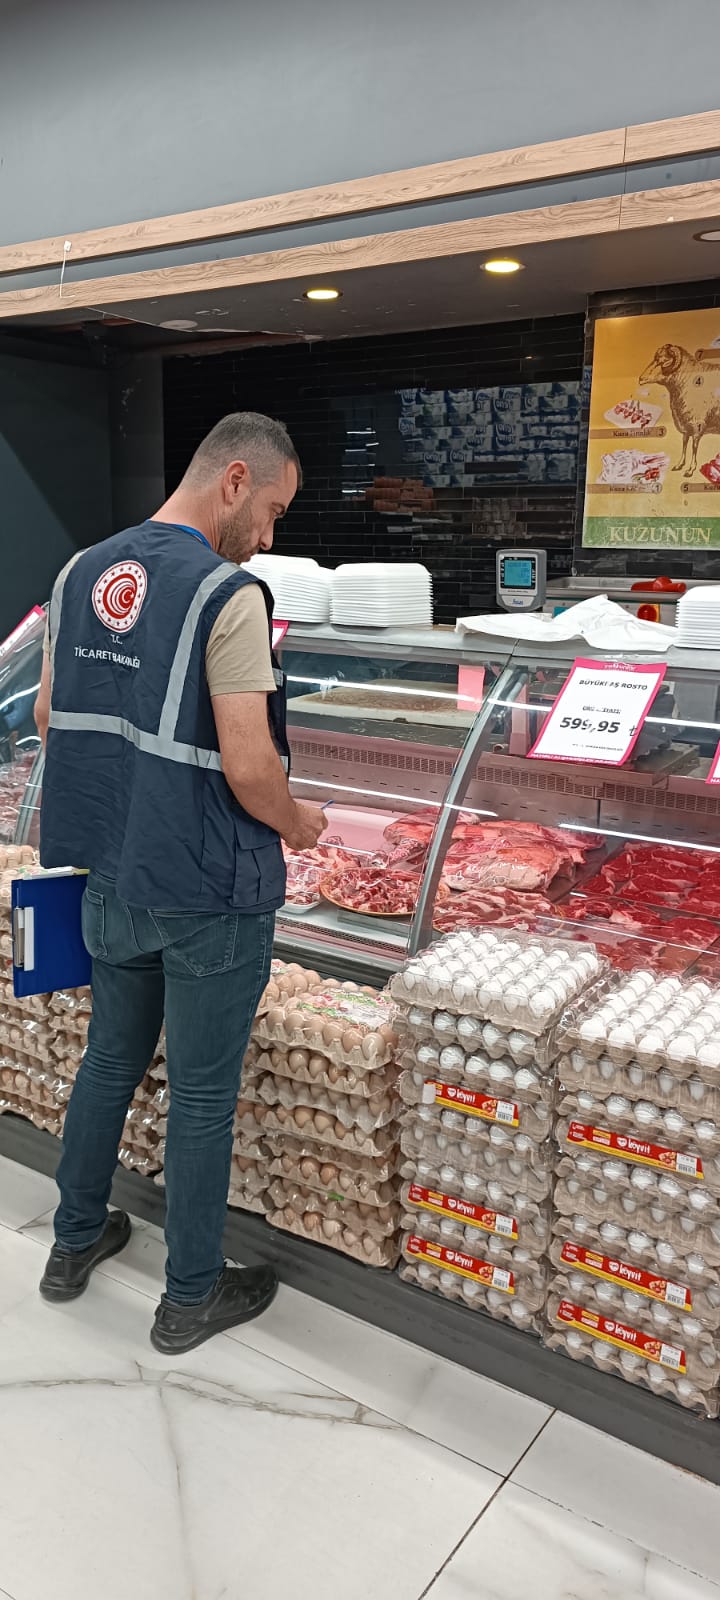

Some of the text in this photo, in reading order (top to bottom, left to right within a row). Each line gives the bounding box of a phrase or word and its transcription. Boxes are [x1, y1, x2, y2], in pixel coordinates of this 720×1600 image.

[695, 376, 702, 386] 4
[658, 427, 664, 437] 3
[683, 484, 689, 492] 5
[609, 527, 712, 543] KUZUNUN
[73, 645, 112, 660] TİCARET
[620, 683, 648, 691] ROSTO
[559, 716, 621, 734] 599,95
